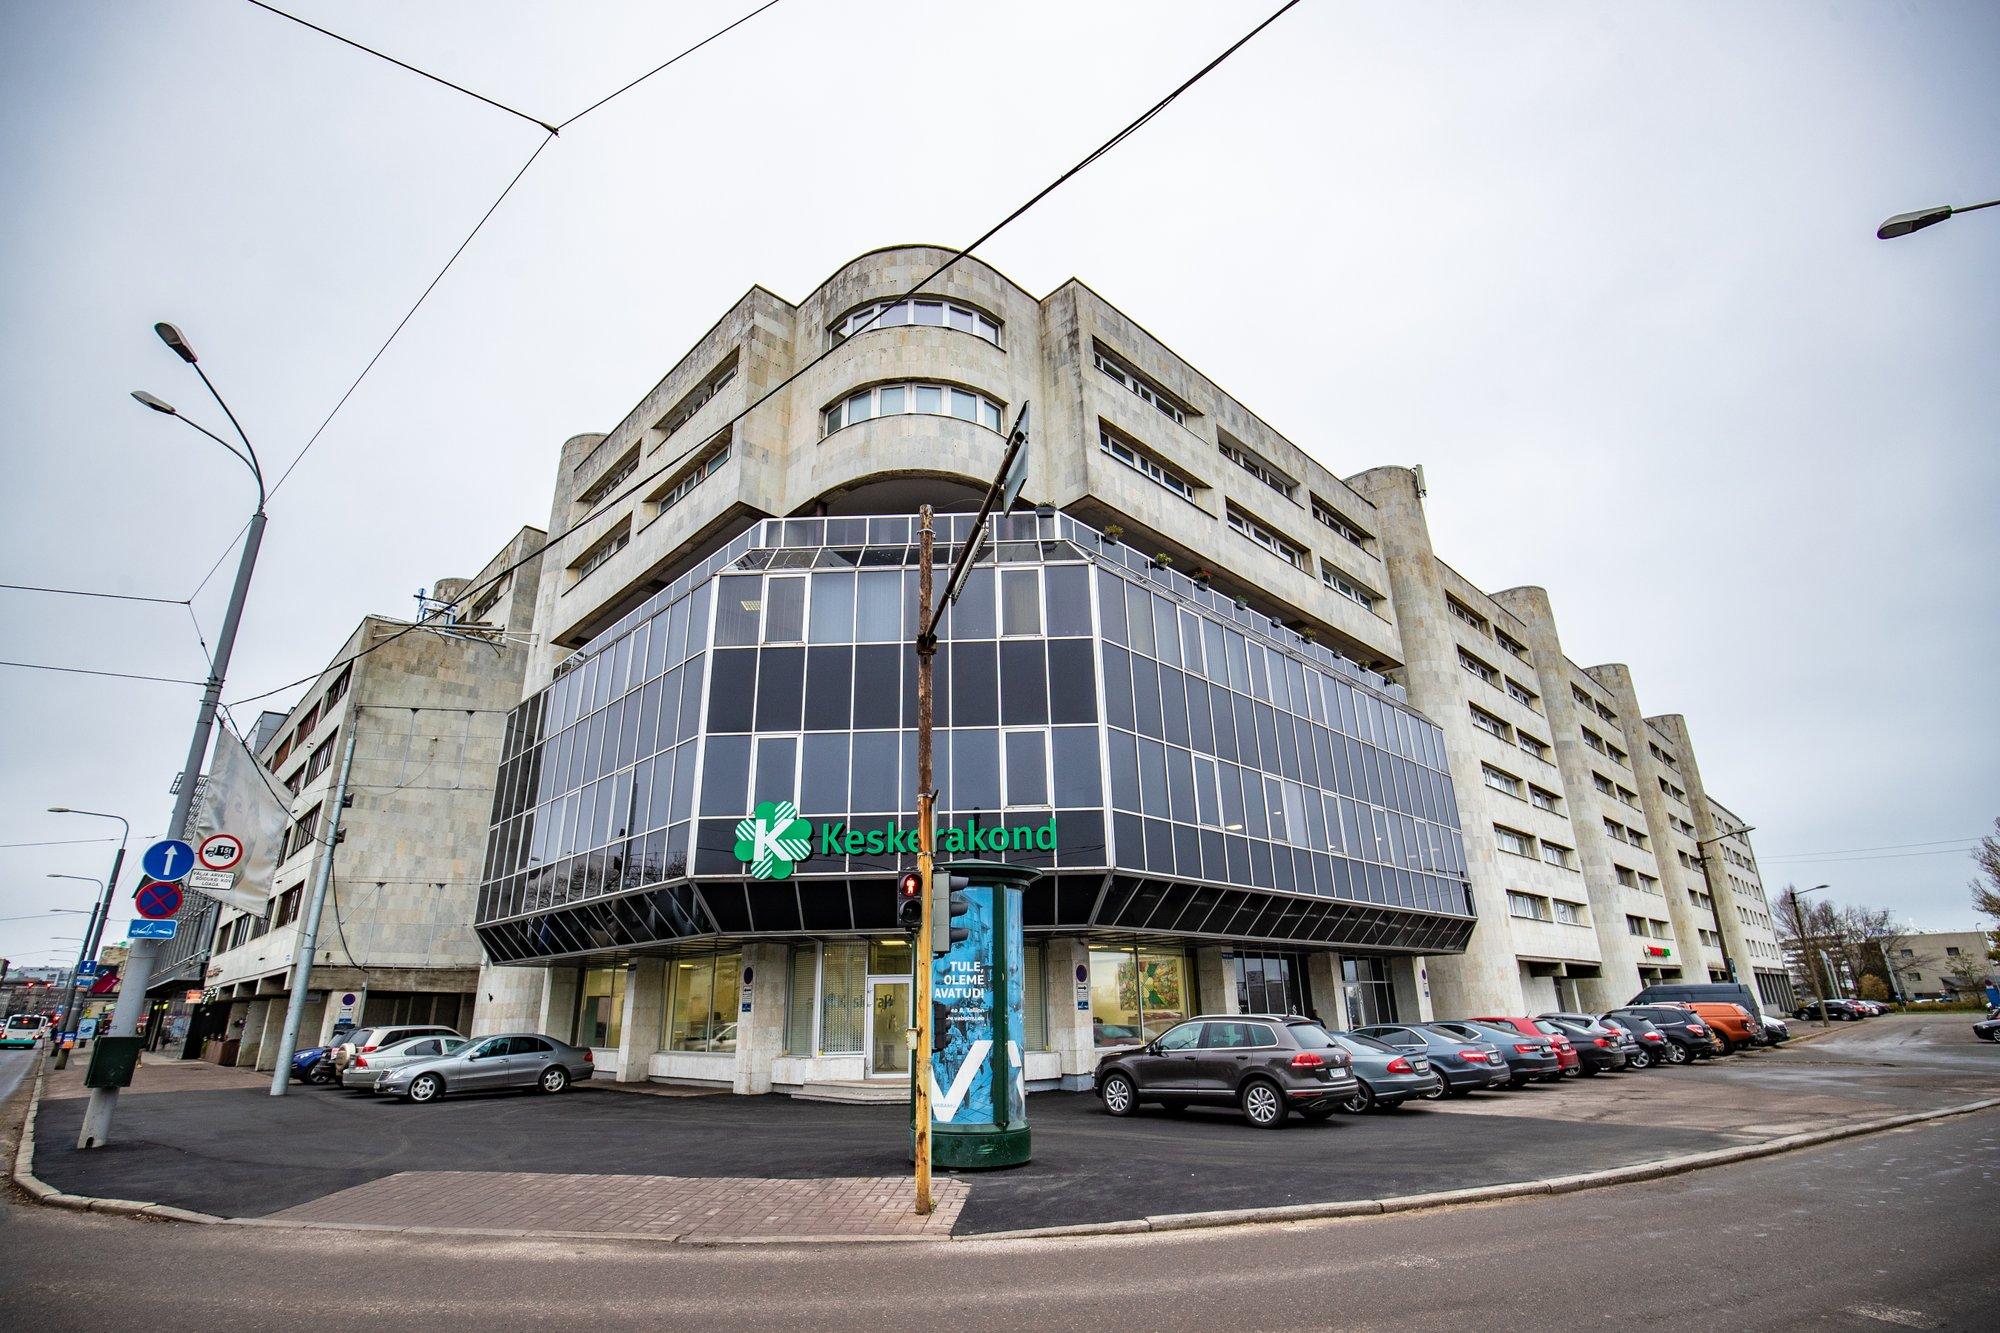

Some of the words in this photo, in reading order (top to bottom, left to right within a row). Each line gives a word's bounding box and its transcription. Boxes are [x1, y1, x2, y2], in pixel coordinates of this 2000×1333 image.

[754, 819, 794, 861] K
[950, 961, 984, 973] TULE,
[943, 974, 985, 985] OLEME
[934, 987, 985, 999] AVATUD!
